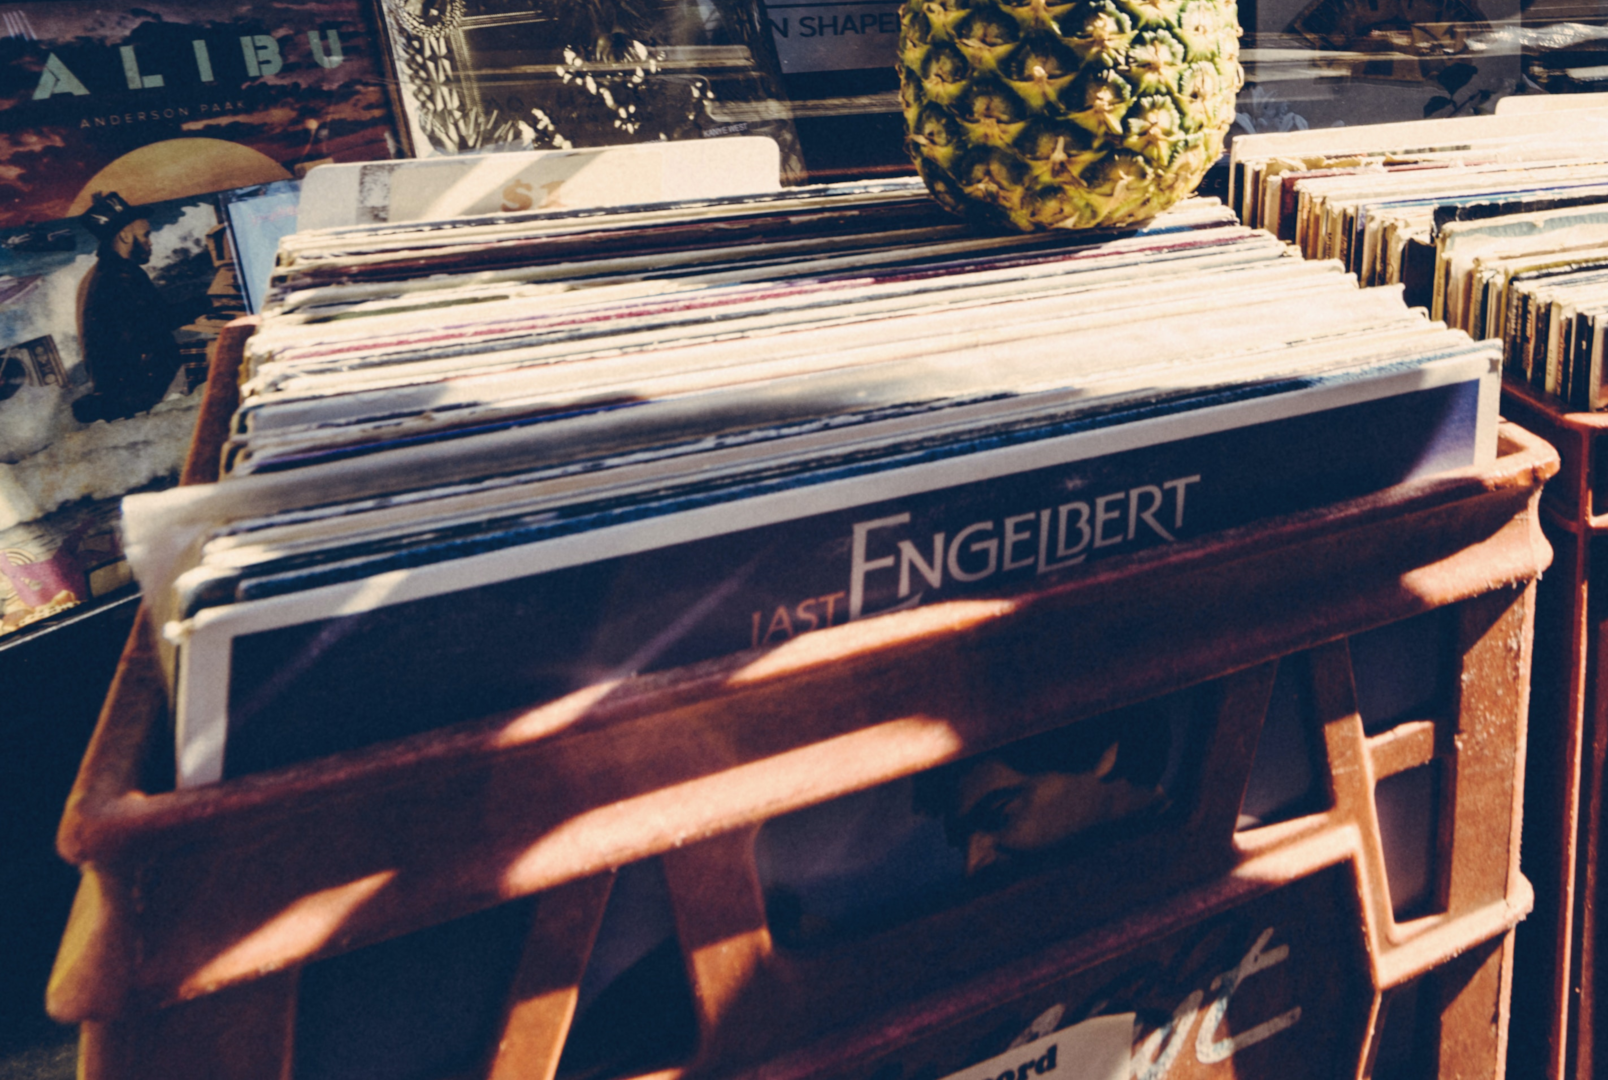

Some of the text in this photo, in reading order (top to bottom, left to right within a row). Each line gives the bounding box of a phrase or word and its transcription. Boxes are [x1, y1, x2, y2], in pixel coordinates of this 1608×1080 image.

[31, 28, 345, 101] ALIBU
[79, 106, 190, 130] ANDERSON
[702, 125, 728, 138] KANYE
[849, 474, 1201, 620] ENGELBERT
